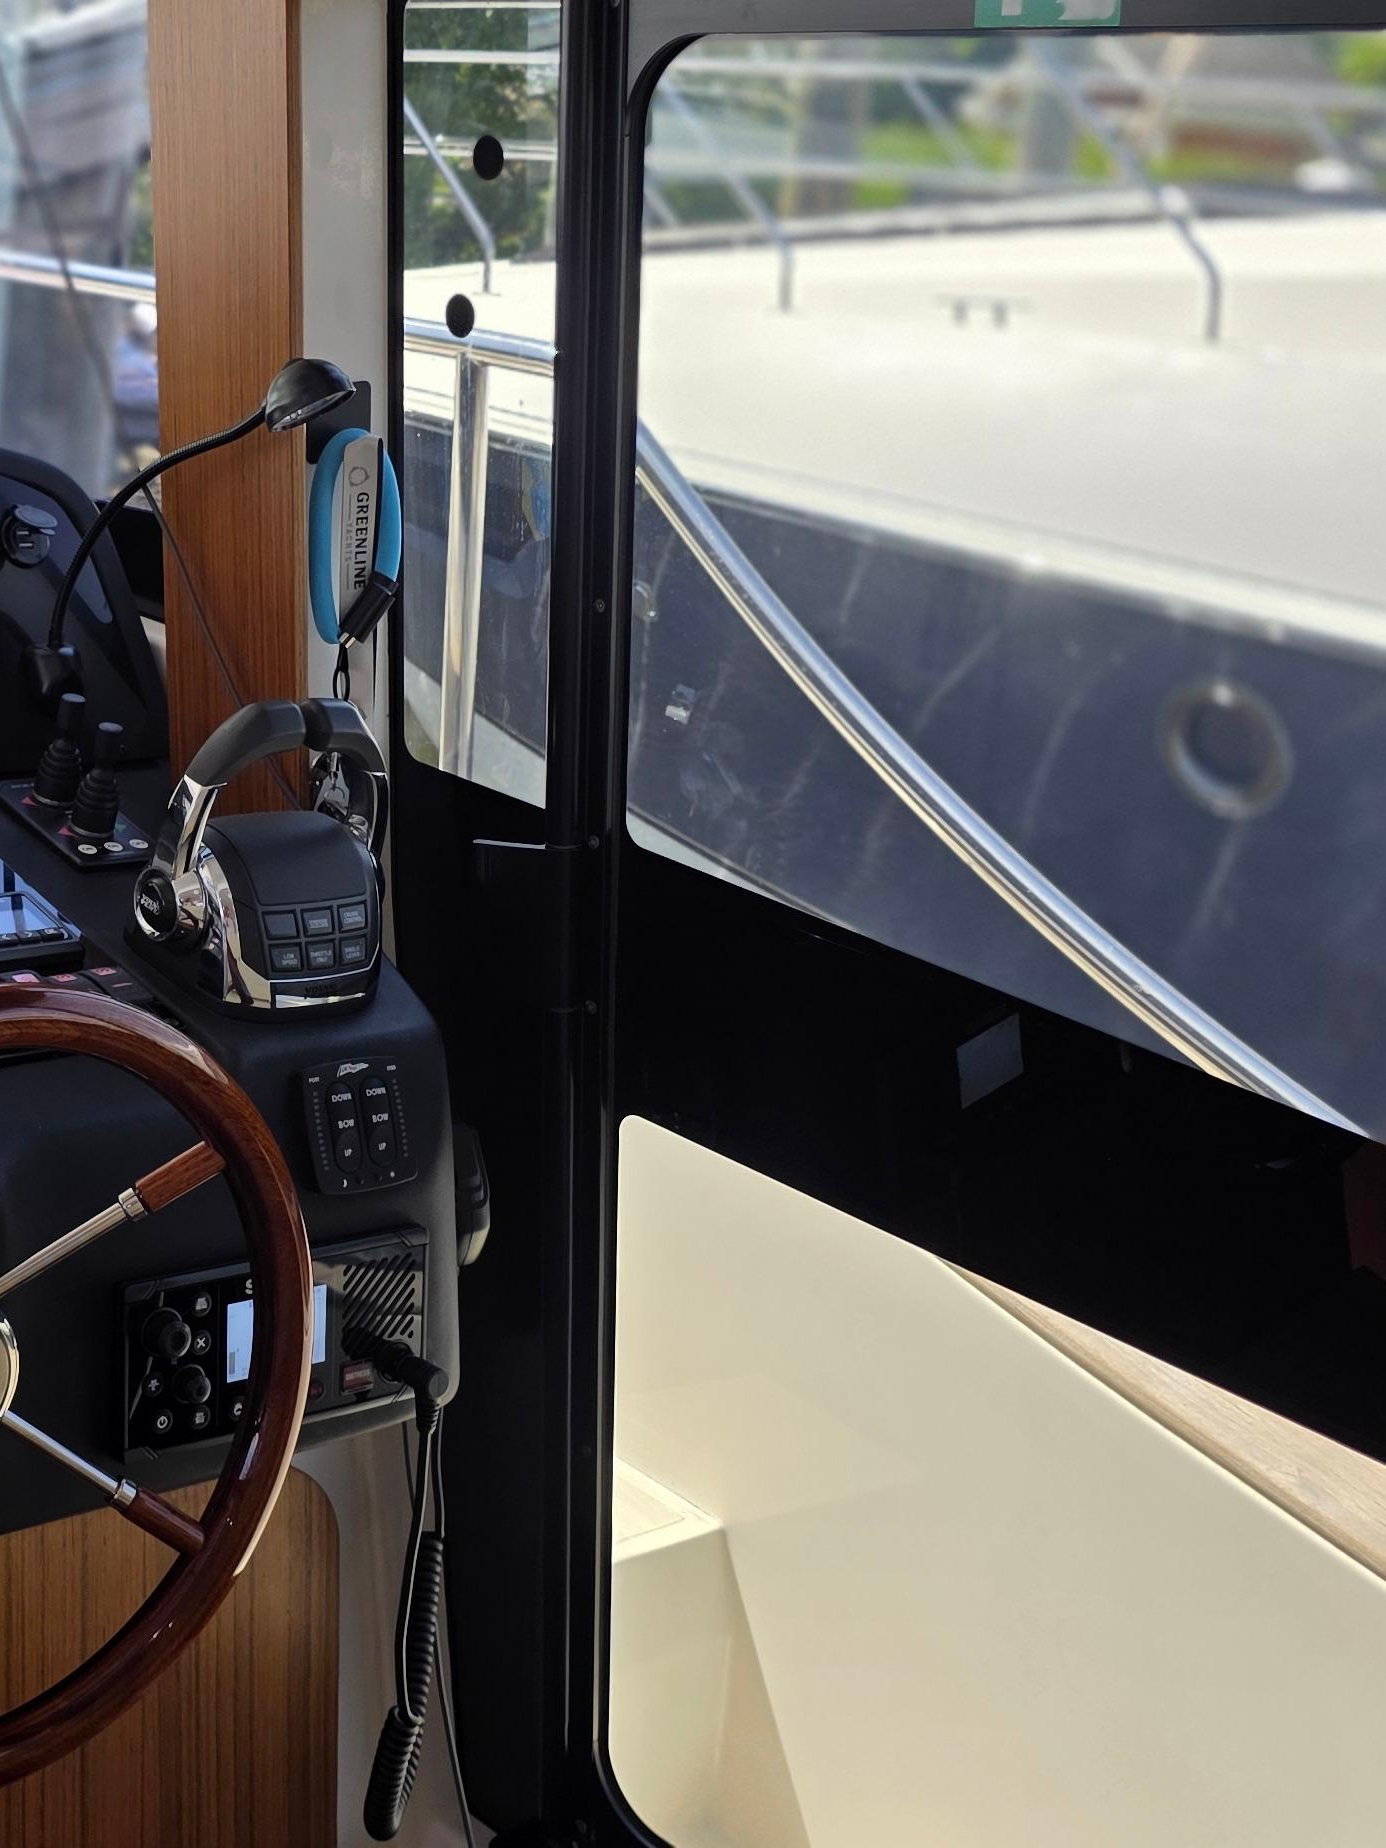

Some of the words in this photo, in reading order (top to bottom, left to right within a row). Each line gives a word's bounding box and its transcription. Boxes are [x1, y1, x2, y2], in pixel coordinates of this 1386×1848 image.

[345, 522, 354, 563] YACHTS
[353, 491, 370, 591] GREENLINE
[366, 1087, 387, 1097] DOWN
[331, 1092, 352, 1103] DOWN
[372, 1113, 389, 1123] BOW
[338, 1119, 354, 1129] BOW
[378, 1142, 387, 1151] UP
[344, 1148, 352, 1157] UP
